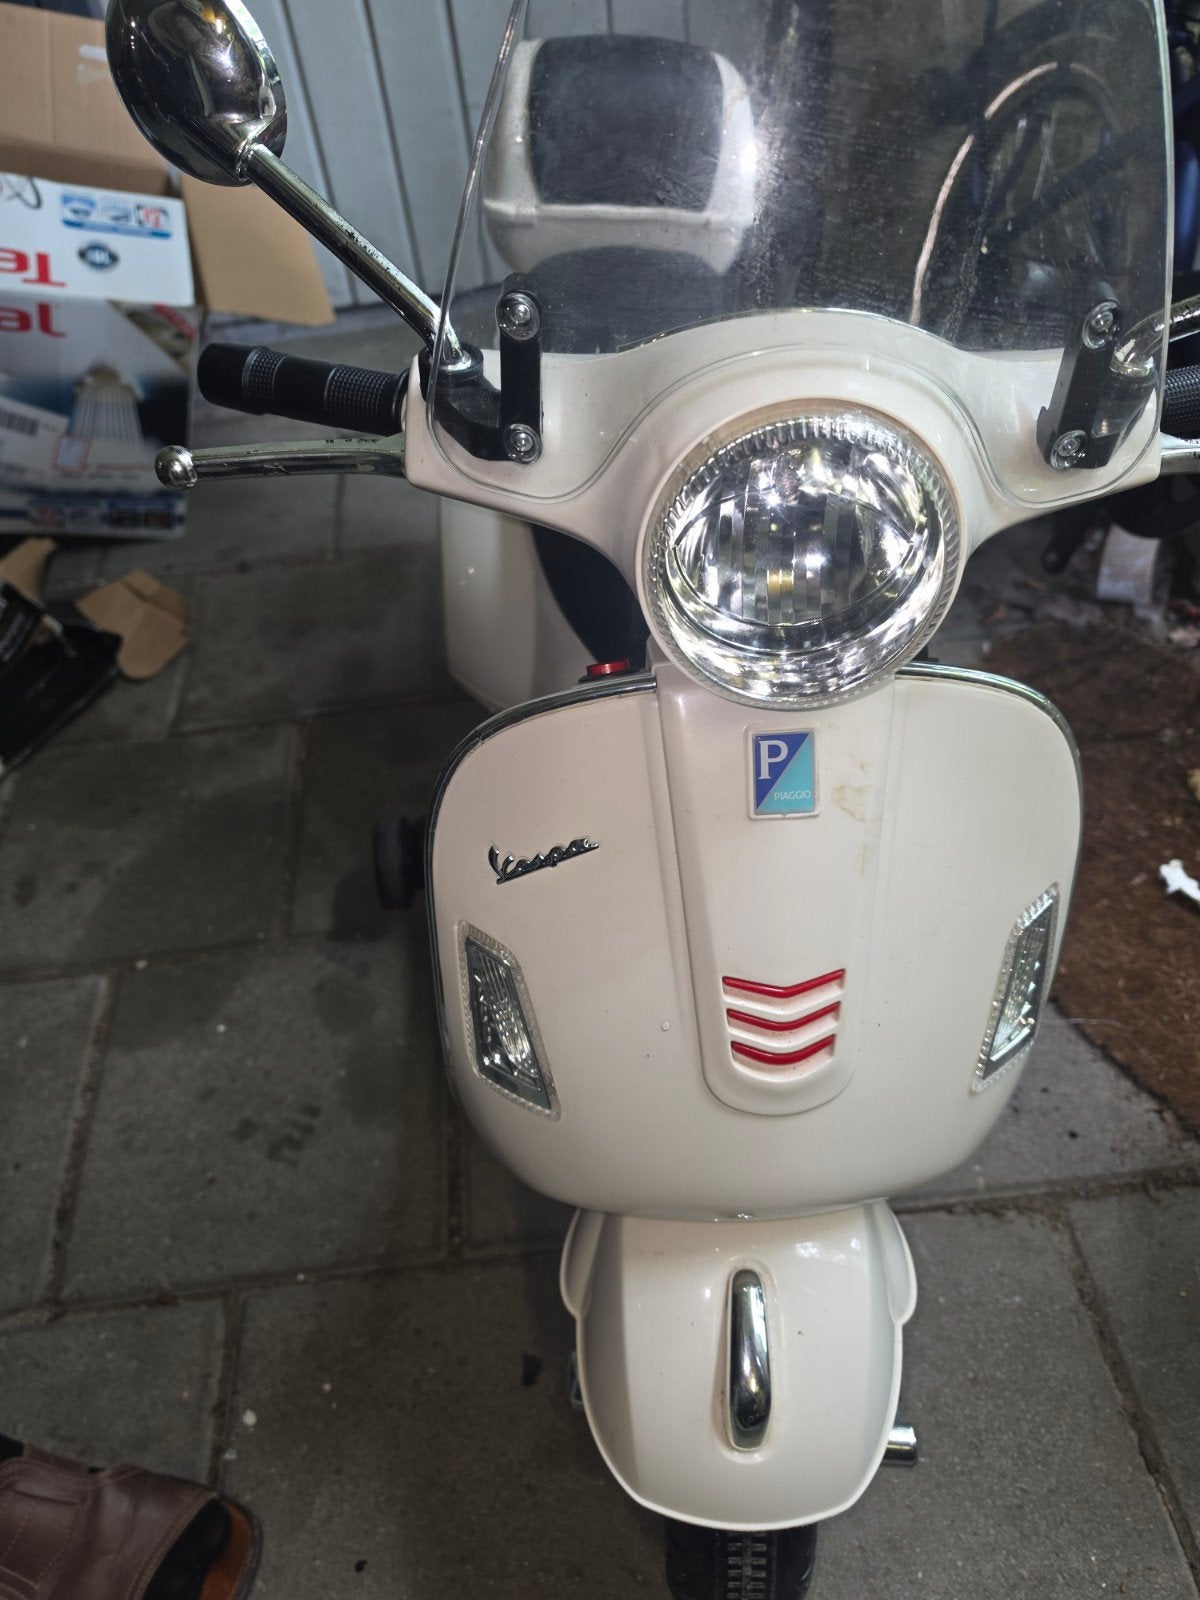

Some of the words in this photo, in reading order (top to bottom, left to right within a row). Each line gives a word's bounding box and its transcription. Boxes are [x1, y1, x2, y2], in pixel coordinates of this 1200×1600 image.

[757, 739, 789, 780] P
[773, 790, 812, 801] PIAGGIO
[488, 837, 600, 885] Vespa
